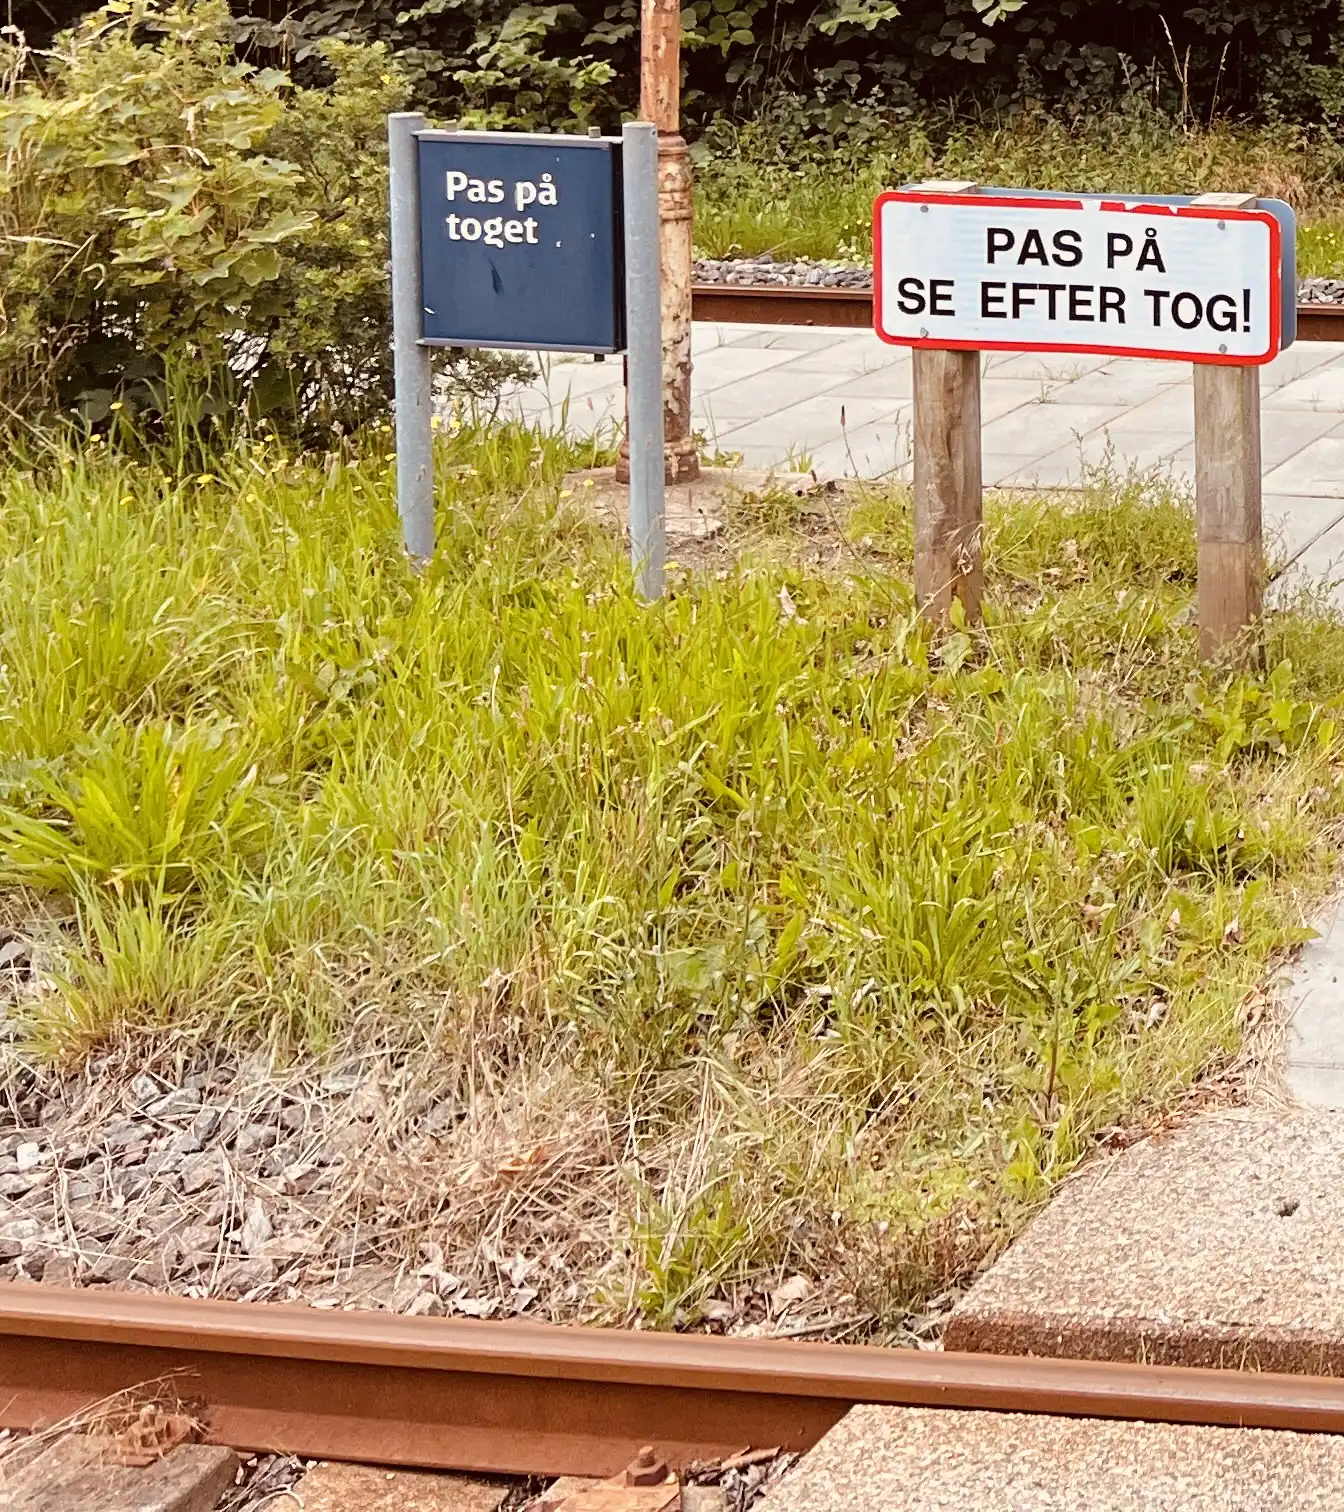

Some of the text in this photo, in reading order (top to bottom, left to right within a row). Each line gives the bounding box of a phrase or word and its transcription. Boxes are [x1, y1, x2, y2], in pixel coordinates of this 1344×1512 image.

[445, 170, 558, 211] Pas på
[446, 212, 539, 249] toget
[986, 227, 1167, 274] PAS PÅ
[897, 277, 1252, 334] SE EFTER TOG!
